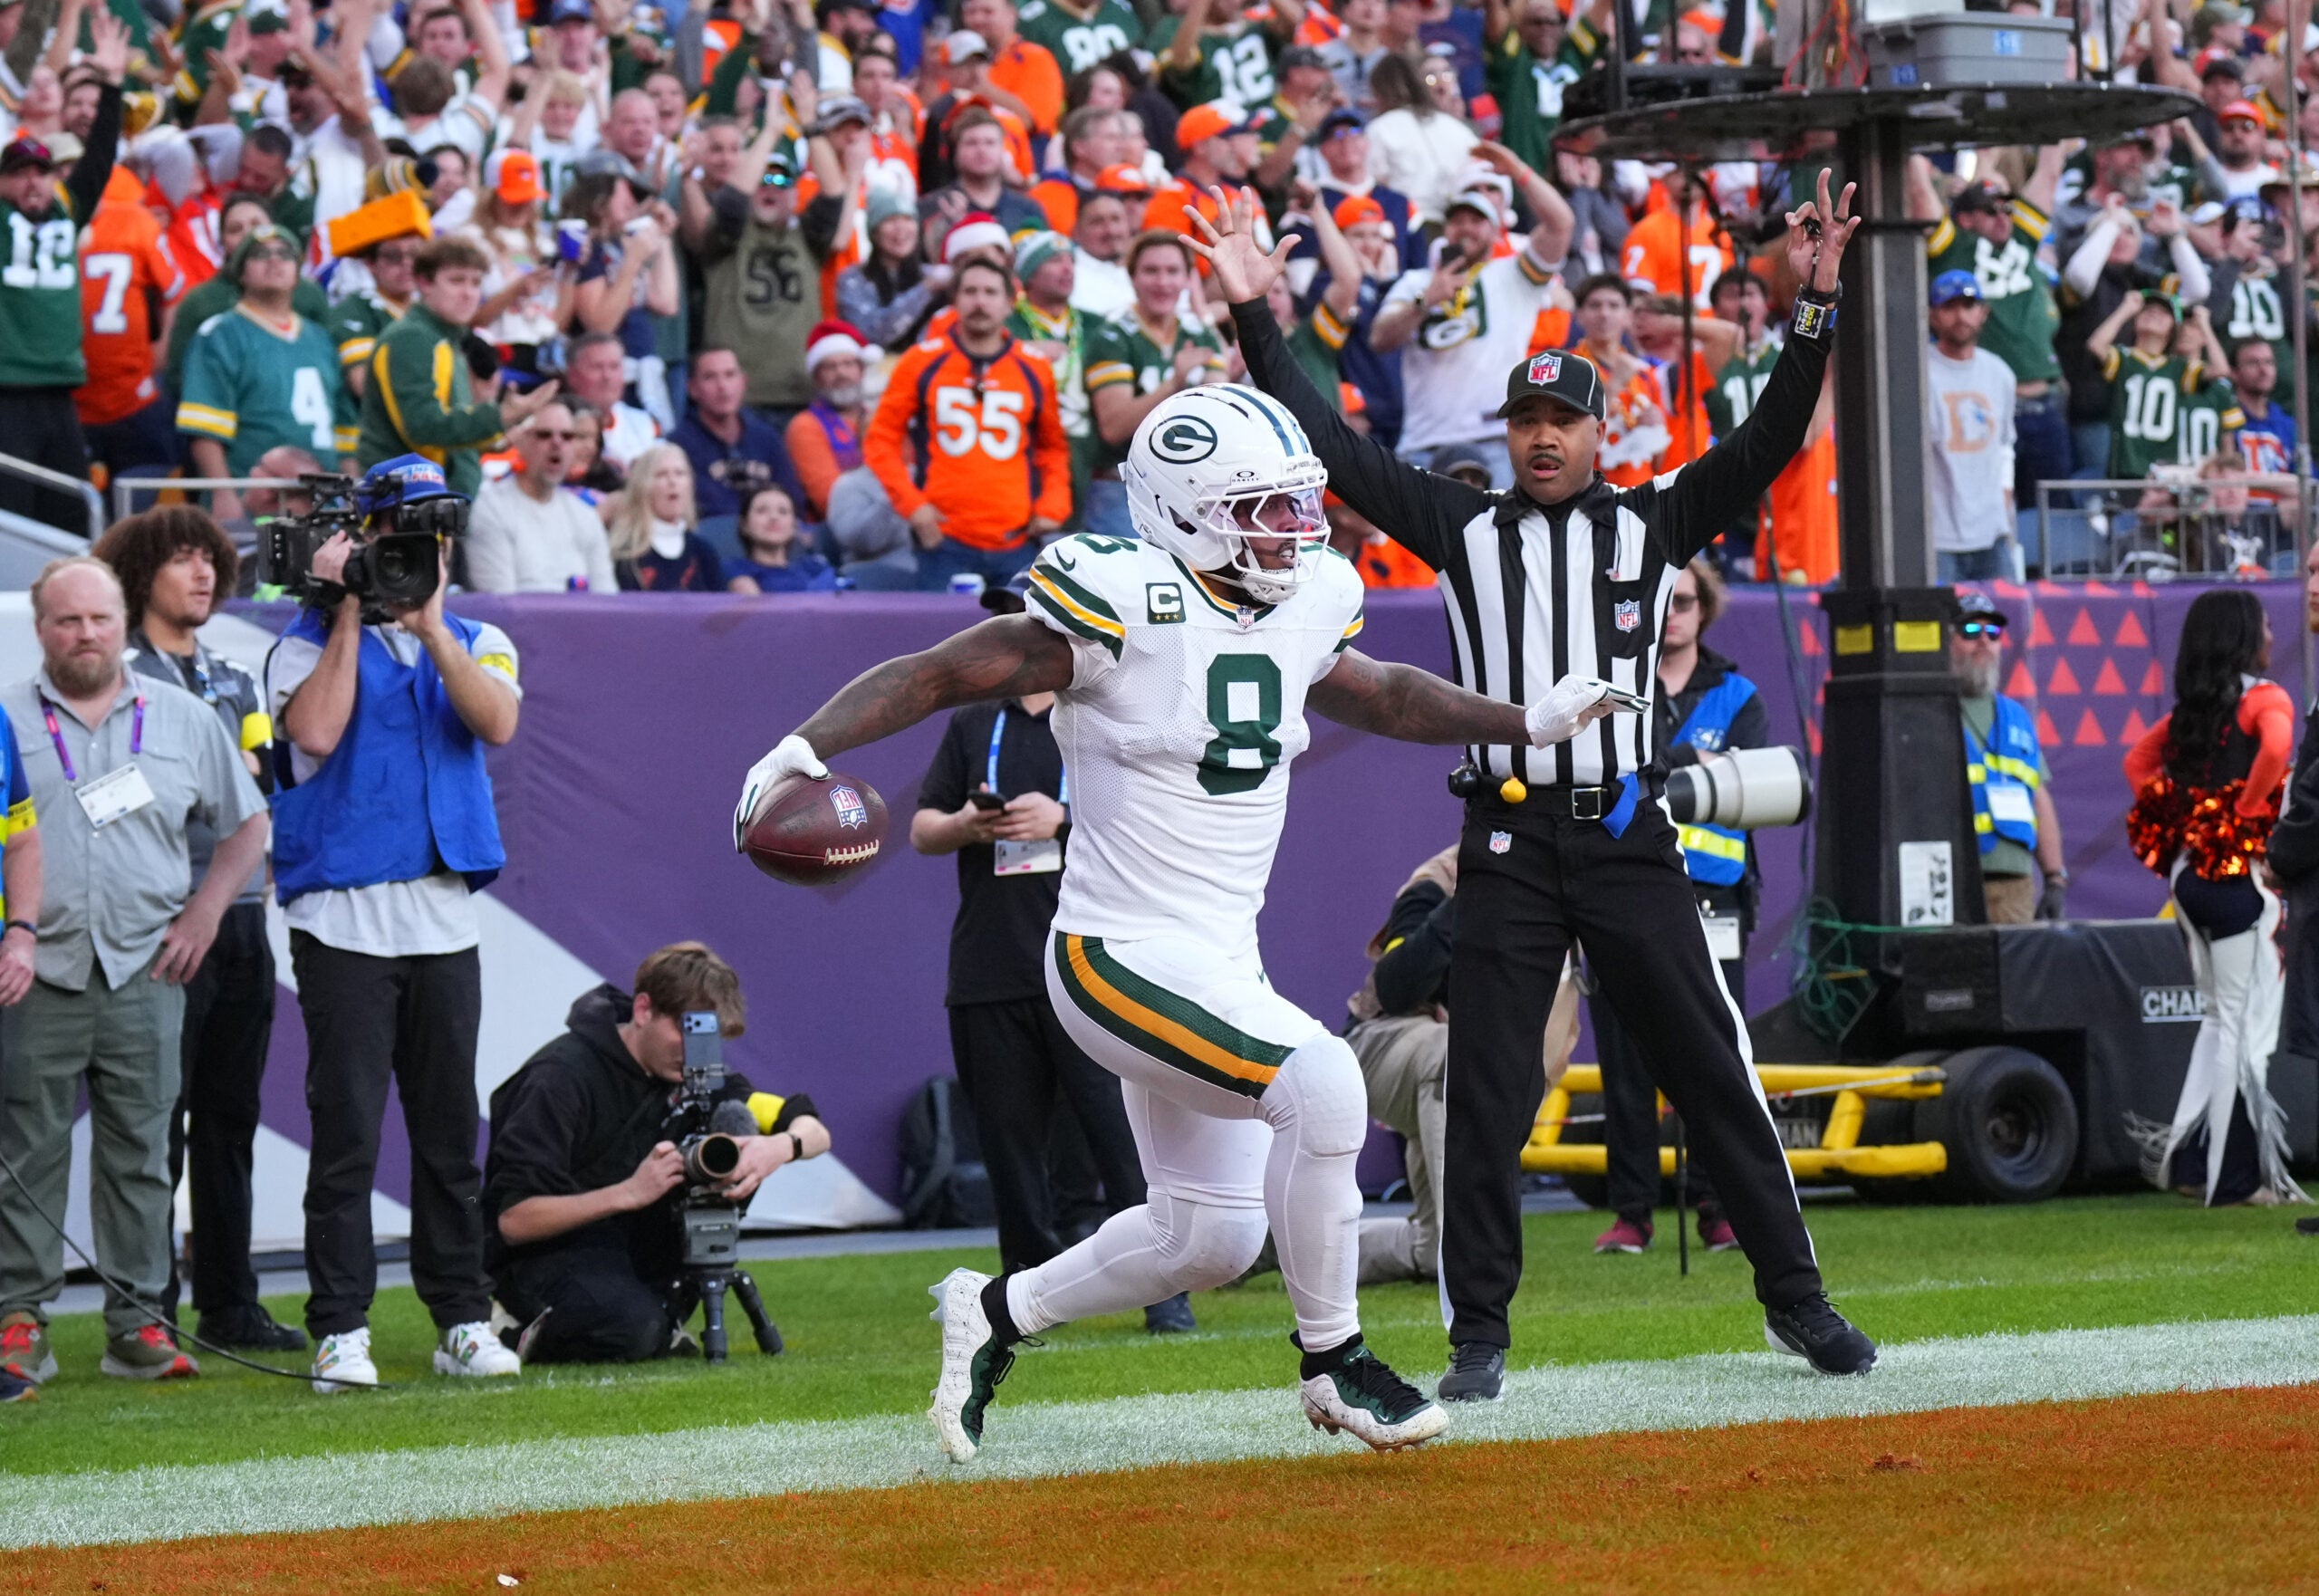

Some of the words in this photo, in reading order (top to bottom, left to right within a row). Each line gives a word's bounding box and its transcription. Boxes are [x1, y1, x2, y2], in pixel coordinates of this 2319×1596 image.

[1212, 33, 1275, 111] 12
[3, 212, 75, 290] 12
[744, 245, 802, 304] 56
[1688, 244, 1722, 310] 7
[85, 252, 132, 333] 7
[2228, 277, 2285, 341] 10
[1530, 365, 1557, 380] NFL
[291, 366, 334, 450] 4
[937, 385, 1023, 461] 55
[2124, 373, 2176, 442] 10
[1149, 584, 1181, 614] C
[1618, 611, 1638, 628] NFL
[1196, 653, 1282, 796] 8
[833, 789, 861, 810] NFL
